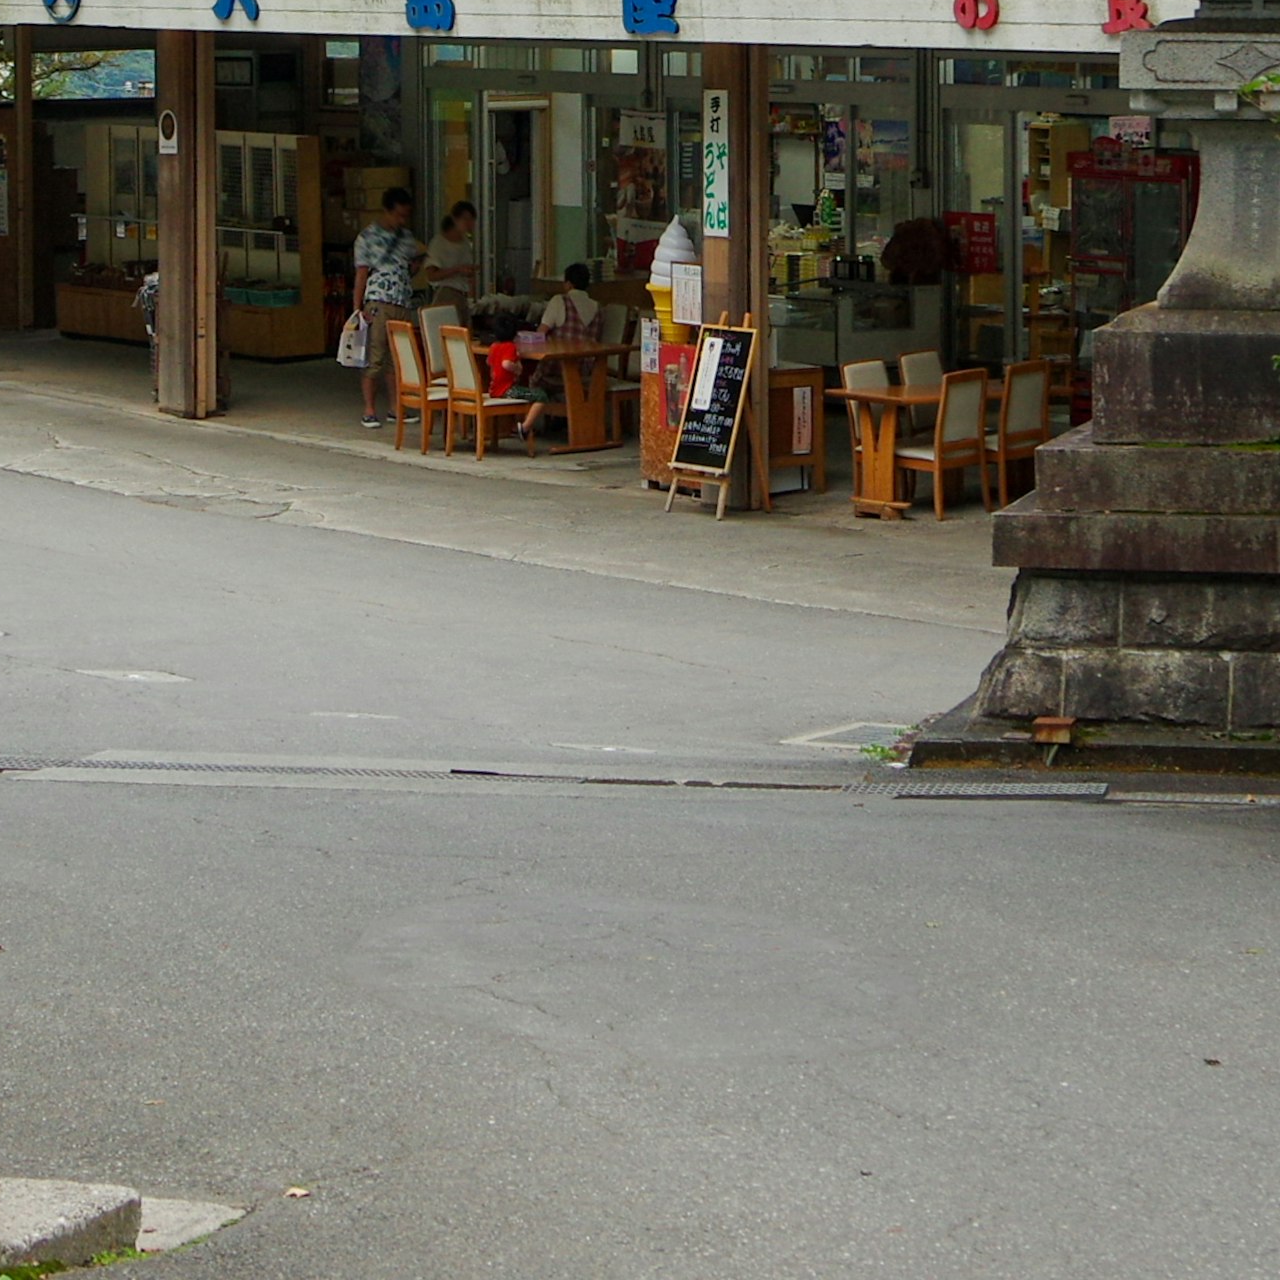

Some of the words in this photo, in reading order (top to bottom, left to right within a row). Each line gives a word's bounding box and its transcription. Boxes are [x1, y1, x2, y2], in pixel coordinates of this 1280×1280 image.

[709, 95, 722, 134] 手打
[705, 142, 716, 229] うどん
[716, 142, 728, 230] そば
